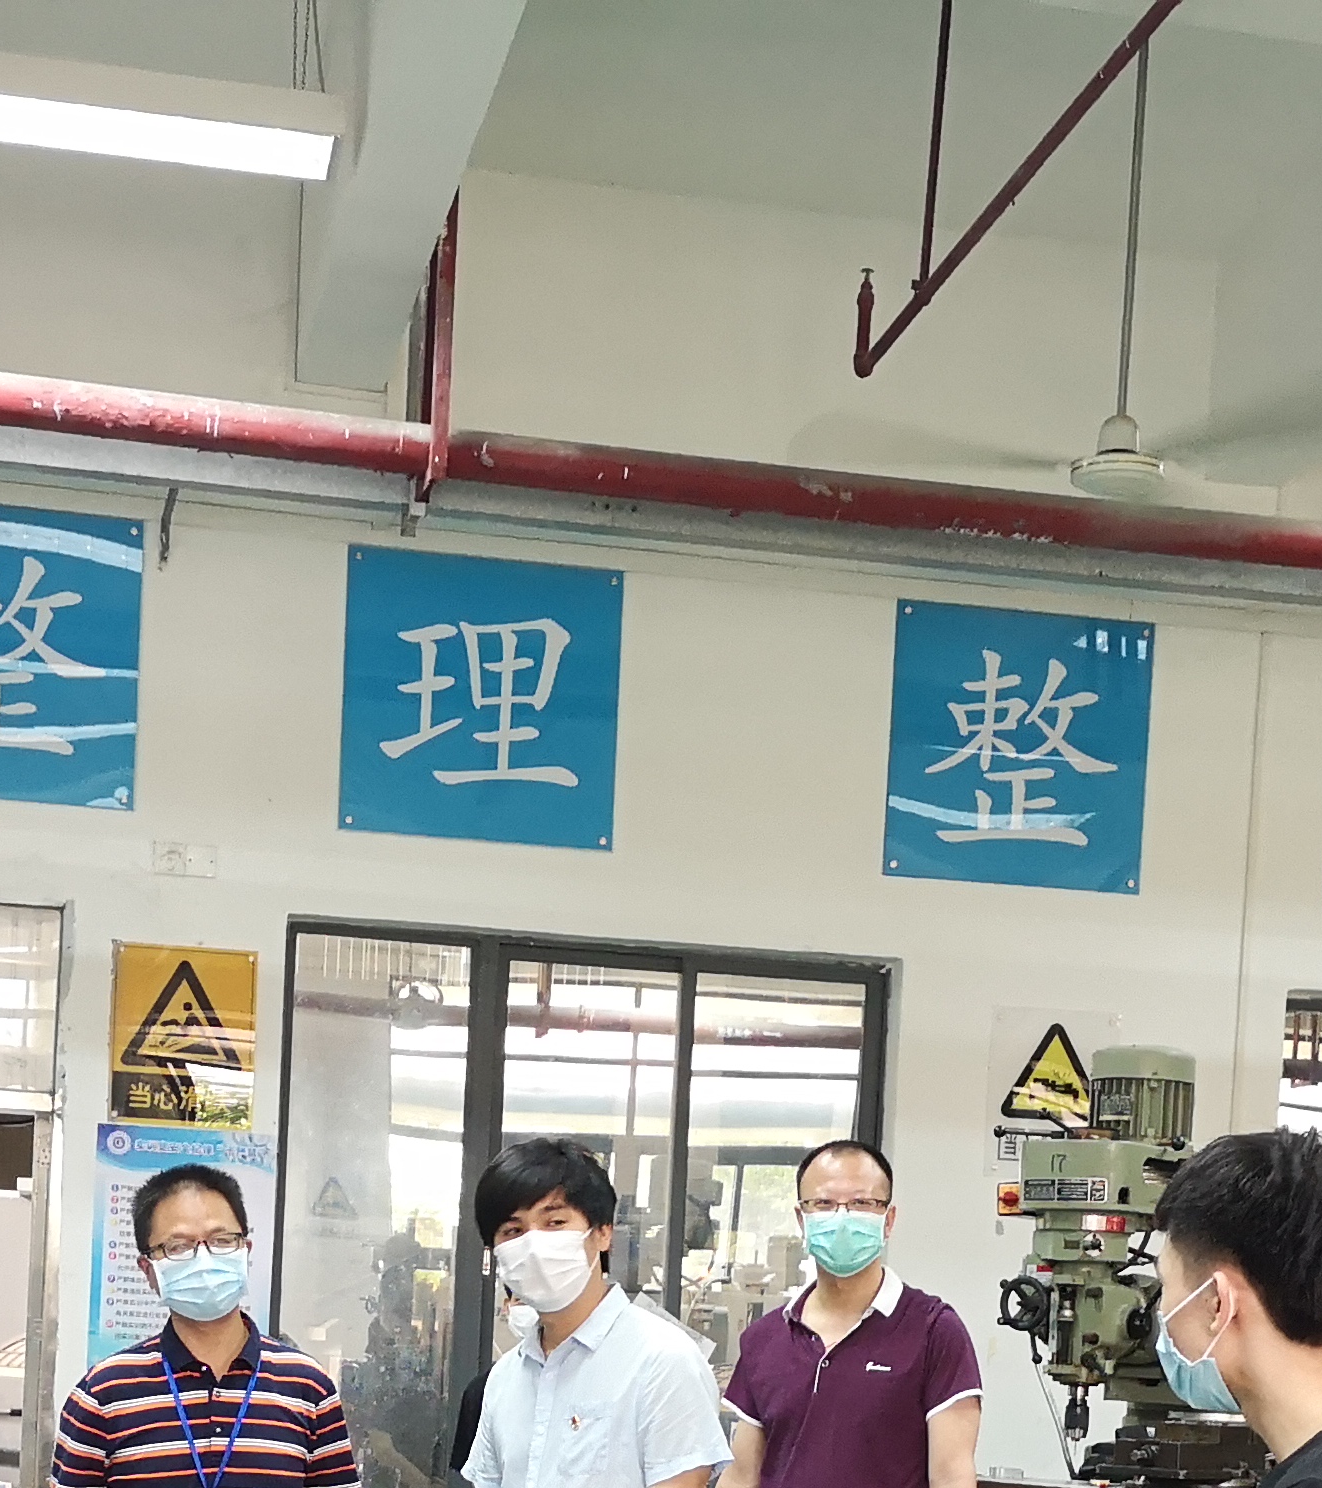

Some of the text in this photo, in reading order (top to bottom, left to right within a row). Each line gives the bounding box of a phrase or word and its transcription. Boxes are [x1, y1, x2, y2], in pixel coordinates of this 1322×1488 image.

[379, 616, 580, 788] 理
[924, 648, 1119, 847] 整
[1050, 1153, 1067, 1173] 17
